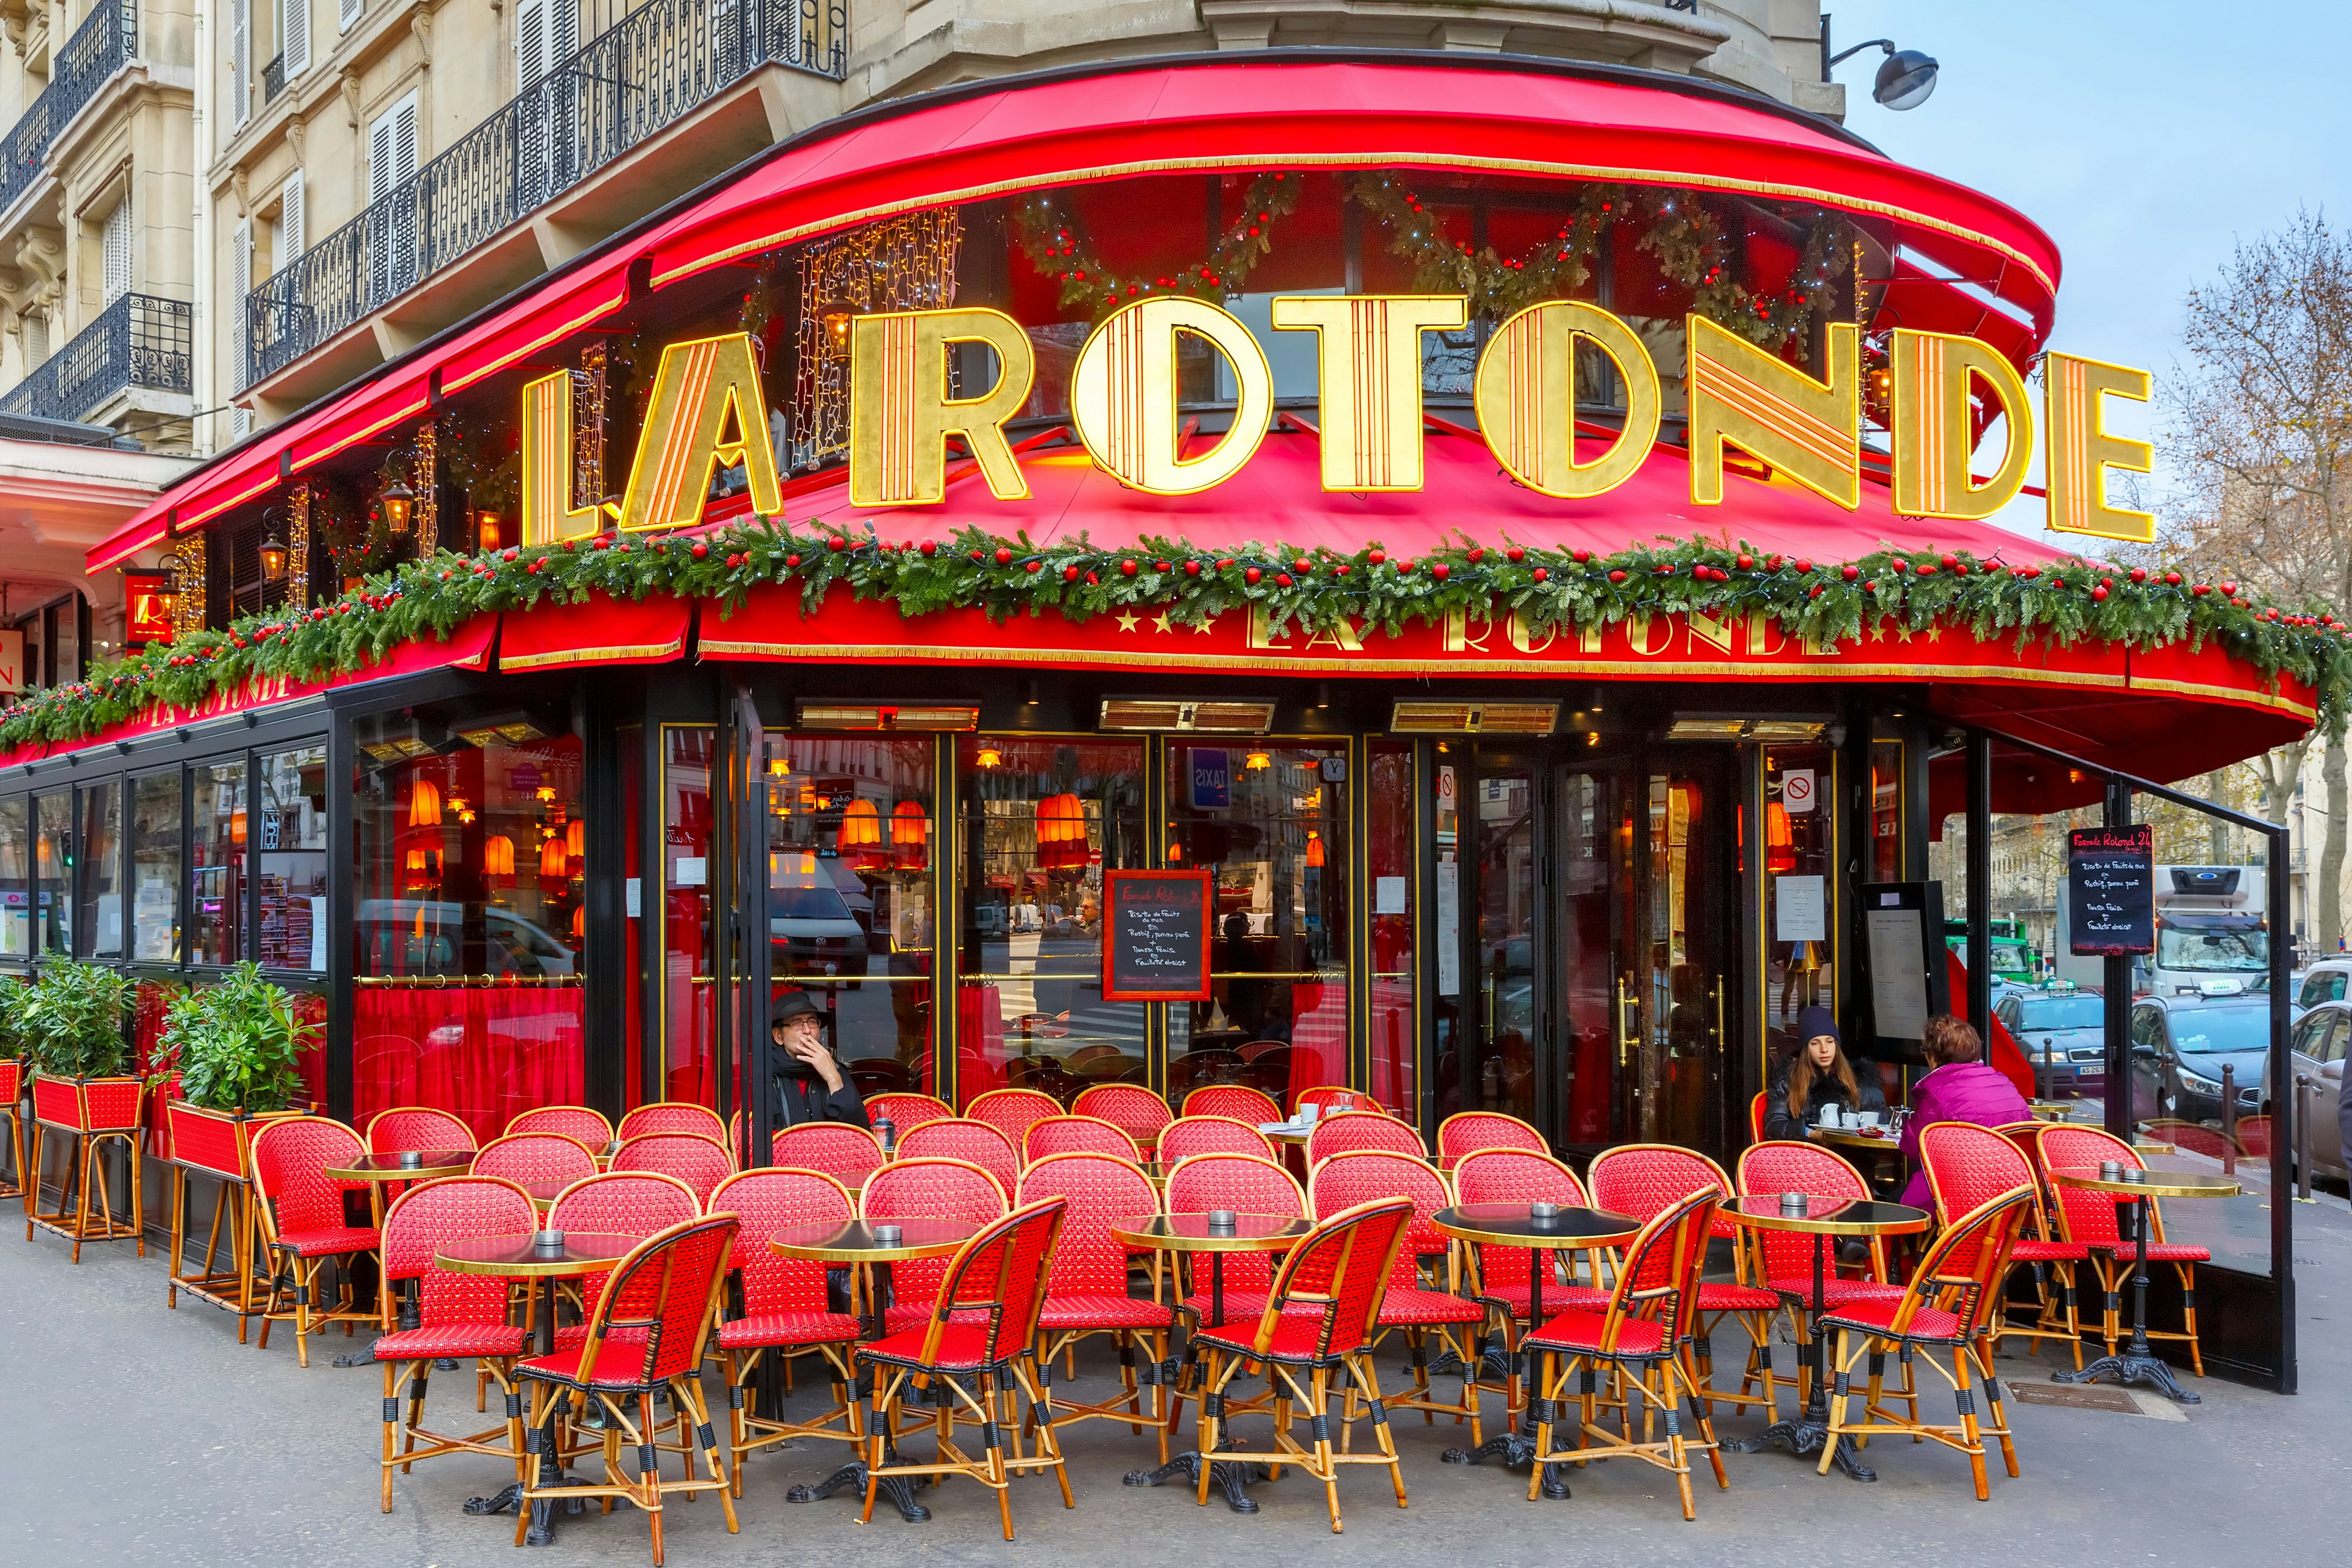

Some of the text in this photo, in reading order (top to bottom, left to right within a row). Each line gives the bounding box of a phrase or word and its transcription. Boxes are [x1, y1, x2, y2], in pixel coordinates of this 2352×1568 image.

[523, 294, 2157, 548] LA ROTONDE
[2073, 834, 2101, 846] Formule
[1122, 886, 1152, 901] Formule
